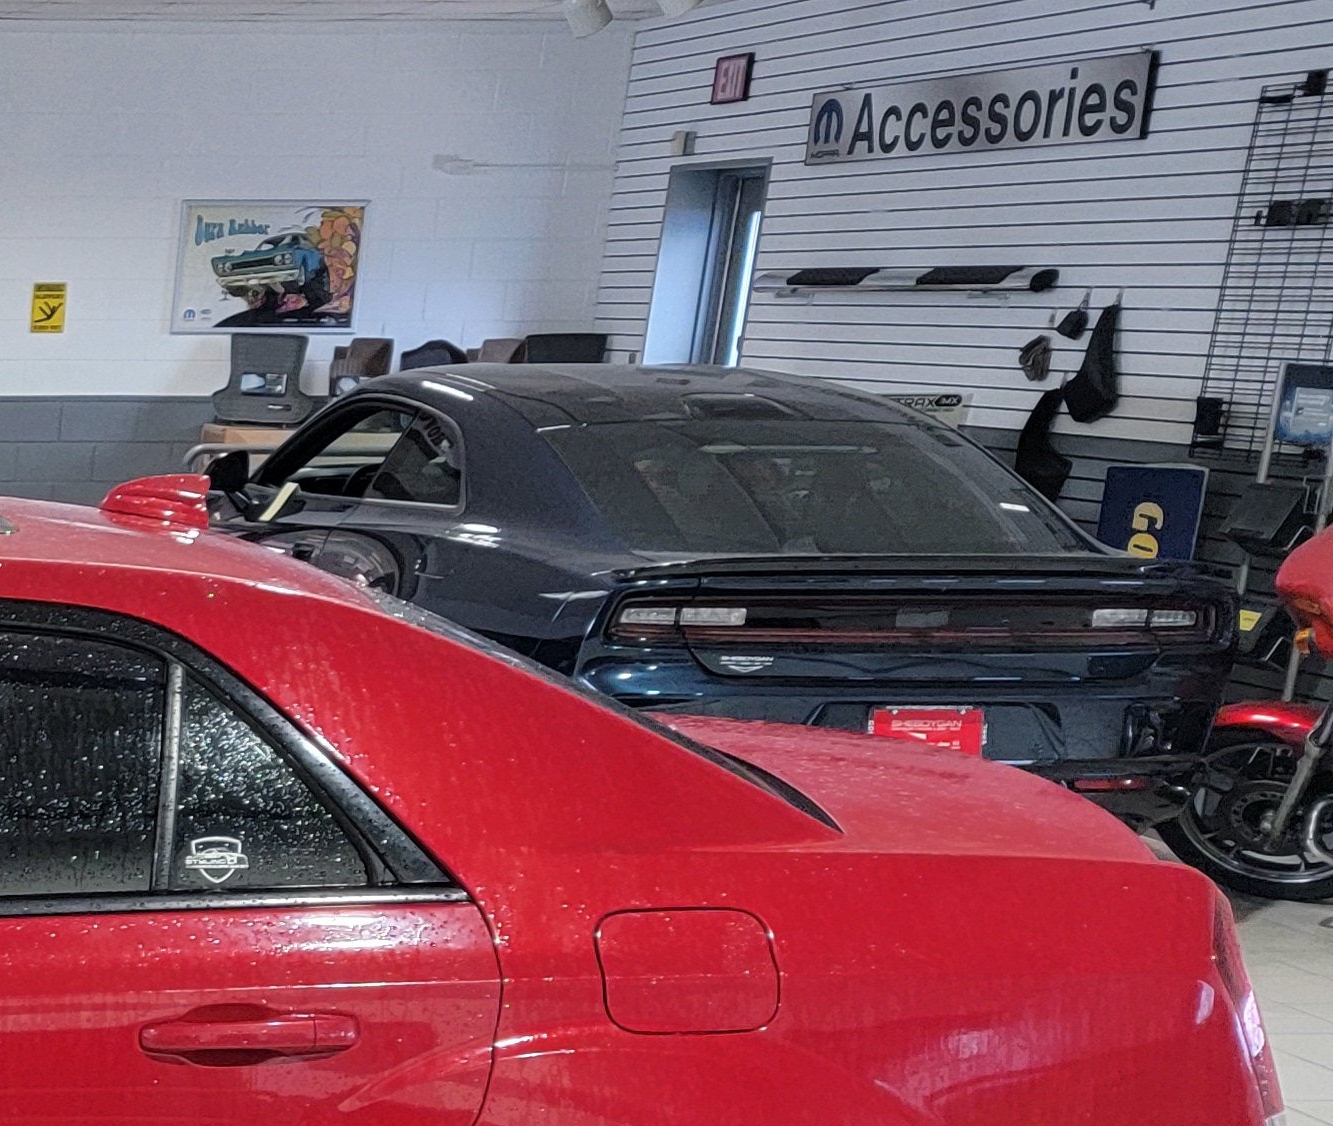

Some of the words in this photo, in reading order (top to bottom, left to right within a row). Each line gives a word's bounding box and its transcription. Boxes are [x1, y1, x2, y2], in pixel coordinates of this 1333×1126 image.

[716, 61, 746, 99] EXIT
[847, 67, 1138, 155] Accessories
[891, 719, 962, 728] SHEBOYGAN
